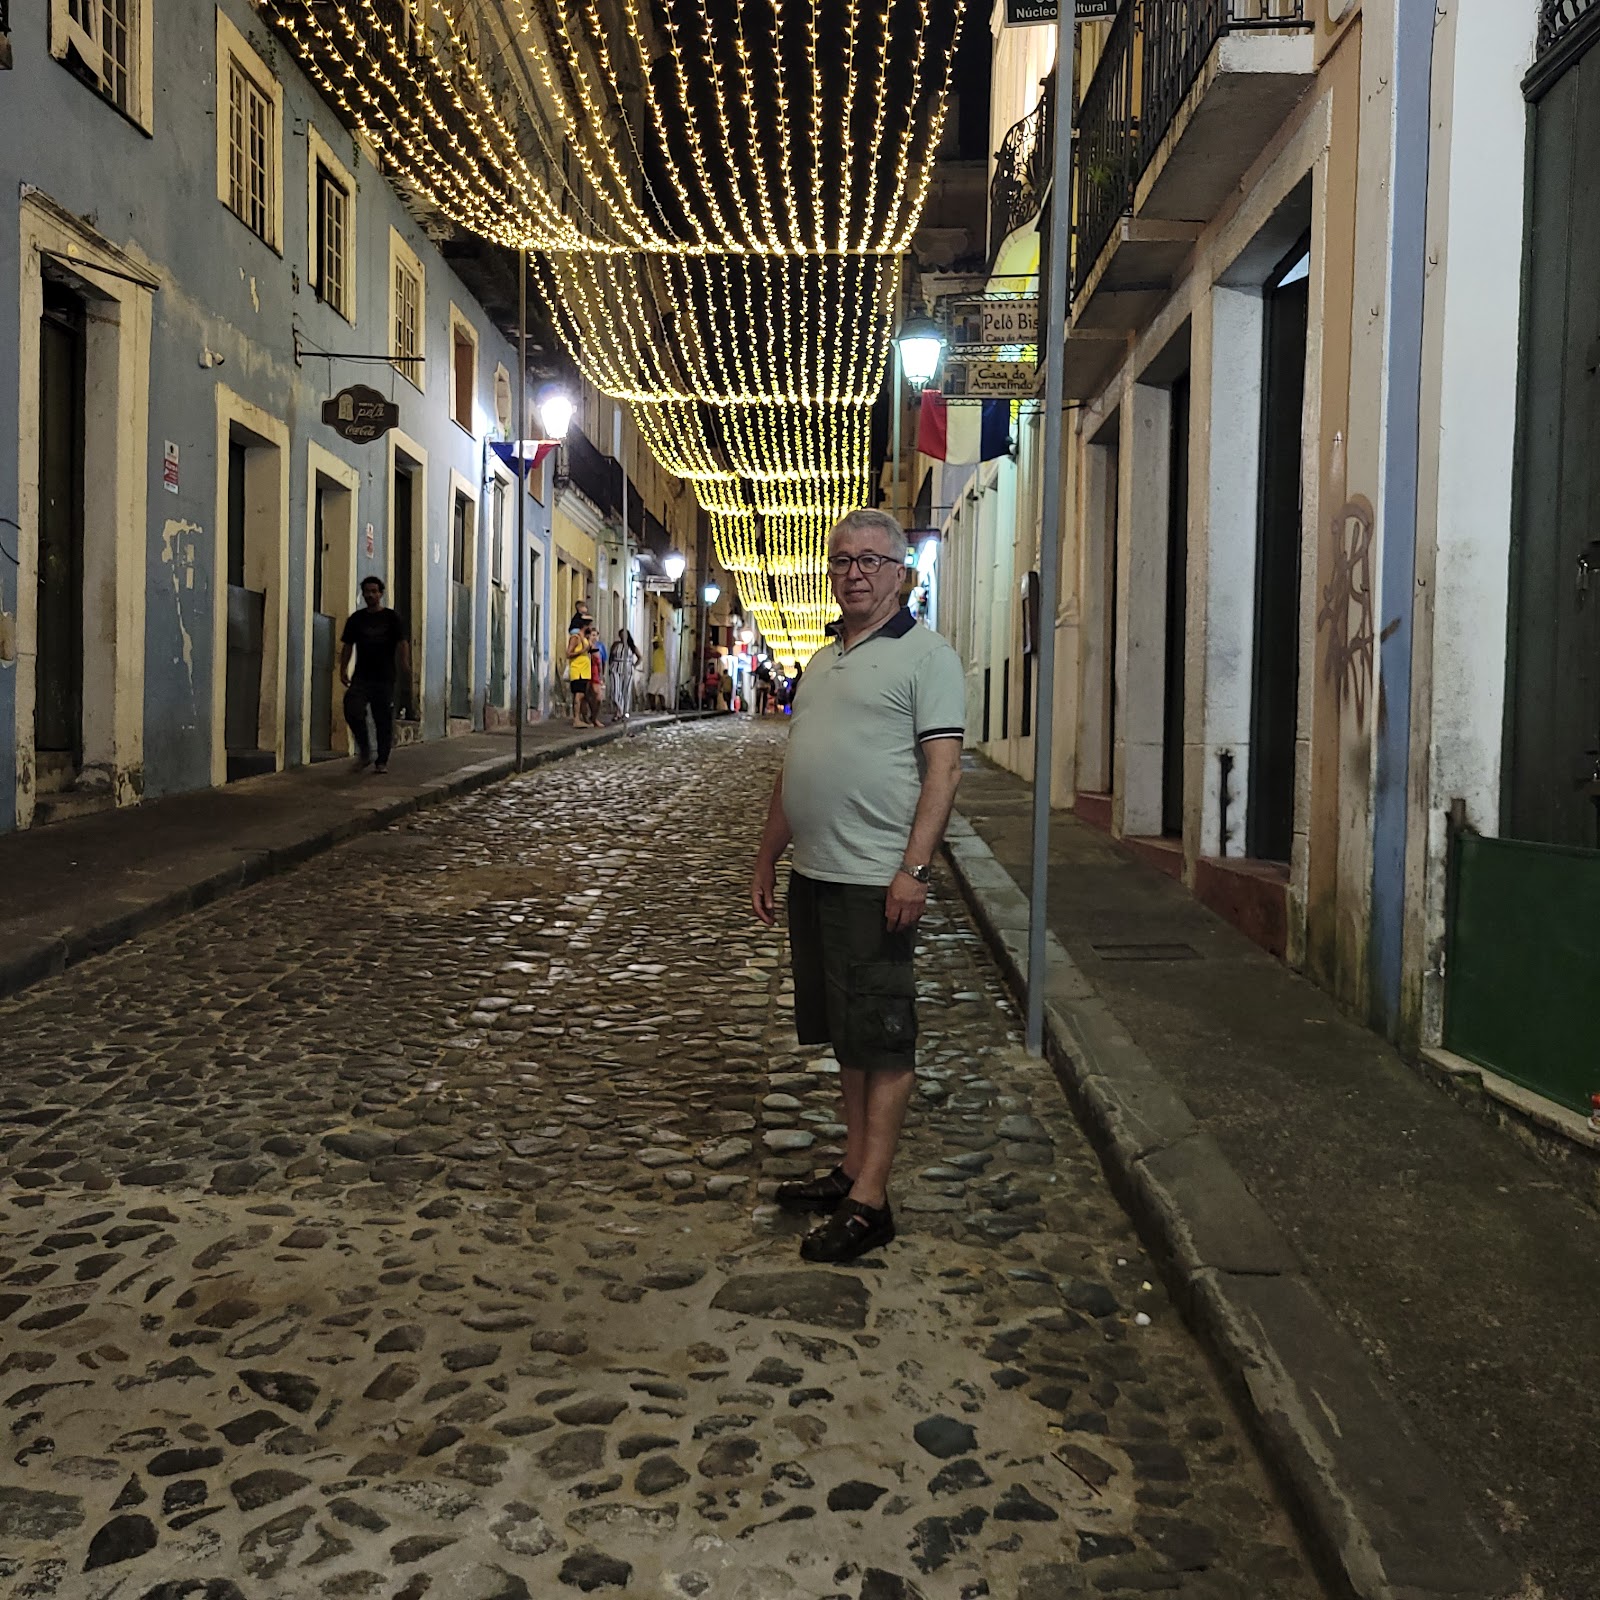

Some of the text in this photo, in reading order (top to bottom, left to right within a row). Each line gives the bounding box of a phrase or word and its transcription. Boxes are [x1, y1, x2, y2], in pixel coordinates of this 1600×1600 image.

[1016, 1, 1107, 19] Núcleo ltural
[1018, 313, 1039, 330] Bis
[978, 368, 1026, 379] Casa do
[972, 378, 1033, 390] Amarelindo
